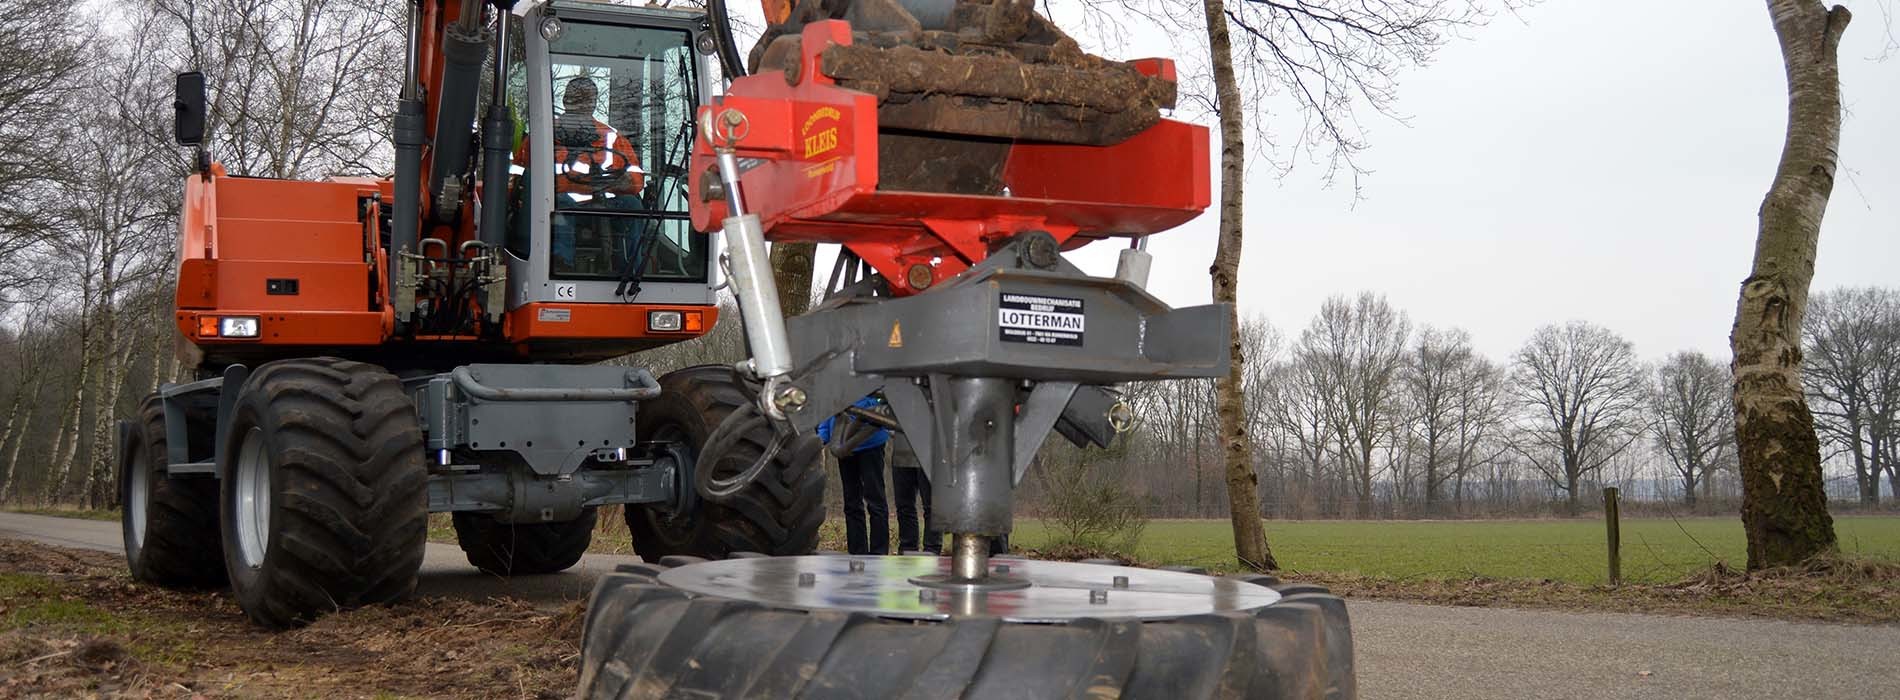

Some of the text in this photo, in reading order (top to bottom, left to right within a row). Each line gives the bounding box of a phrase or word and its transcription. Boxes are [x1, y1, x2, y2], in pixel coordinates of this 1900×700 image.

[805, 127, 837, 159] KLEIS
[558, 286, 573, 297] CE
[1002, 312, 1081, 329] LOTTERMAN
